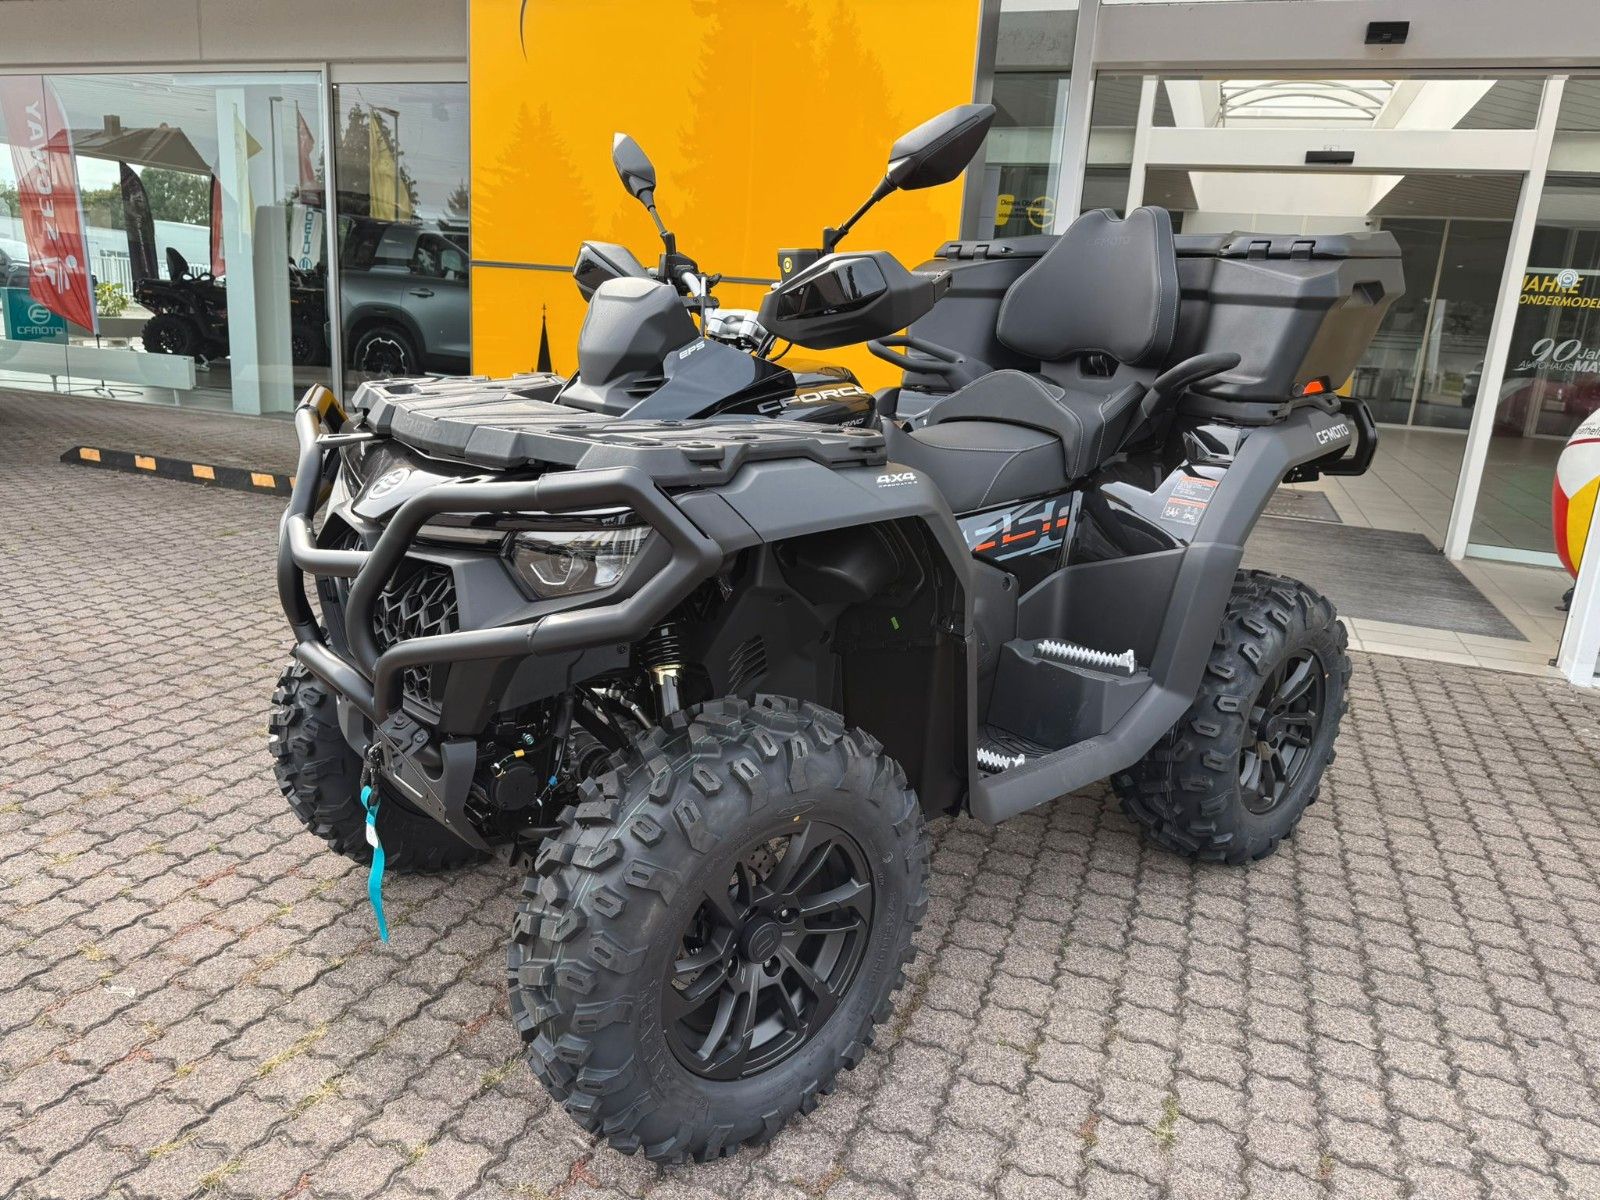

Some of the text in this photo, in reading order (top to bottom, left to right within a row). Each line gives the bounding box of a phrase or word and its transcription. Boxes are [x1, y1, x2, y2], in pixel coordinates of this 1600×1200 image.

[303, 206, 314, 254] CFMO
[17, 326, 64, 335] CFMOTO
[679, 340, 705, 360] EPS
[1531, 338, 1581, 362] 90
[1316, 424, 1349, 445] CFMOTO
